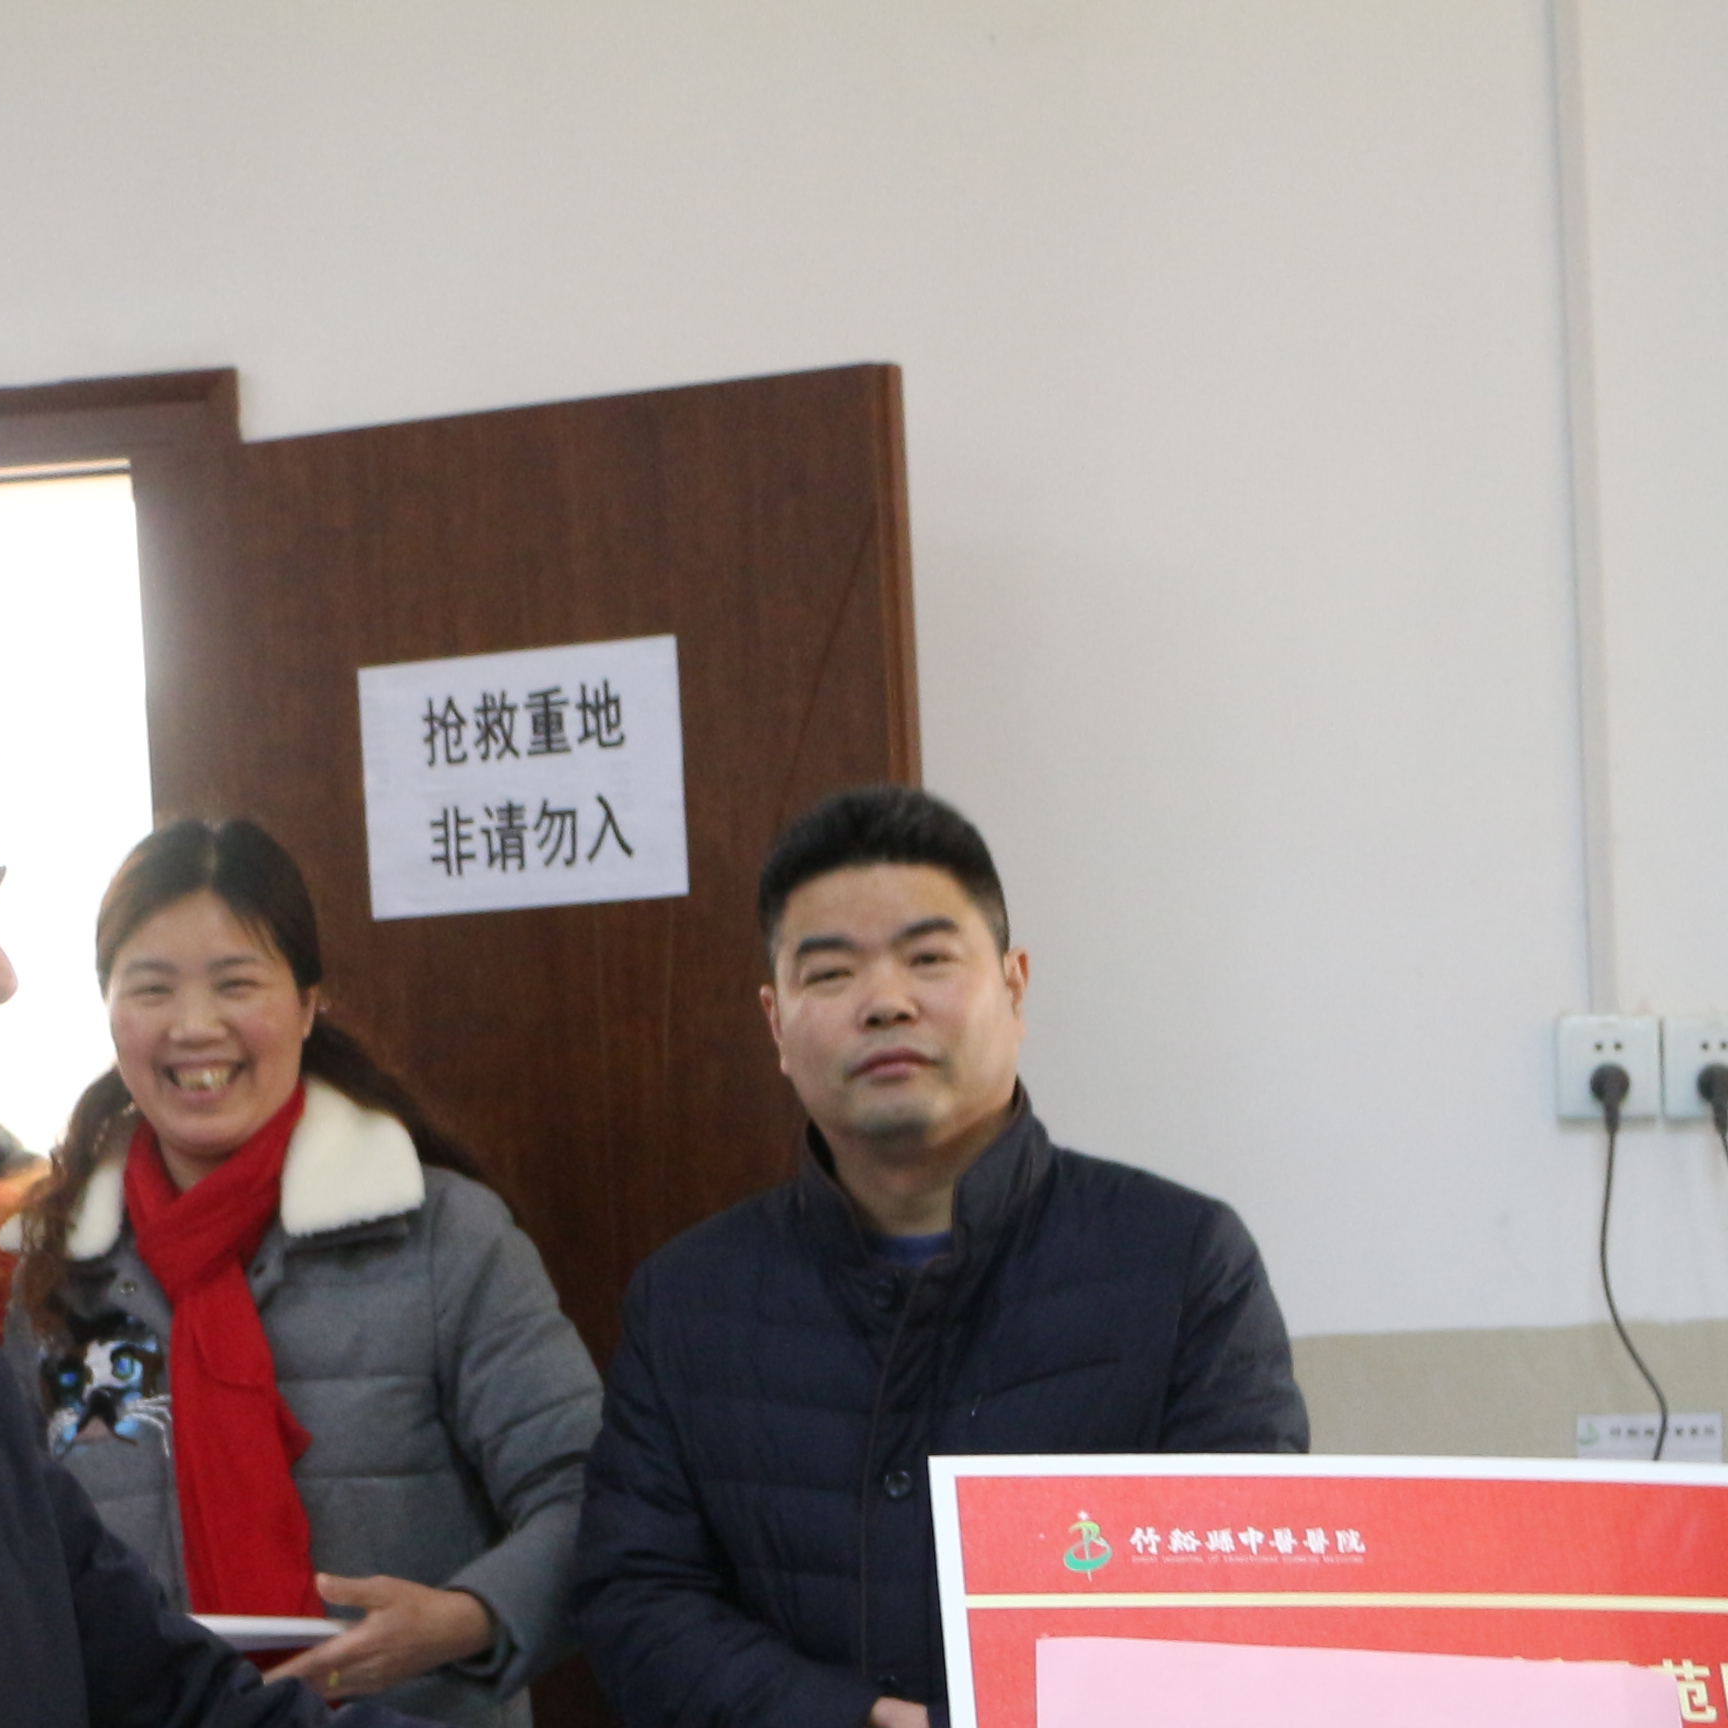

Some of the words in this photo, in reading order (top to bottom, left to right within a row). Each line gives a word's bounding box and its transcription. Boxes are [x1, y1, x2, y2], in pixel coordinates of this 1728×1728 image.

[421, 678, 626, 768] 抢救重地
[429, 794, 635, 878] 非请勿入
